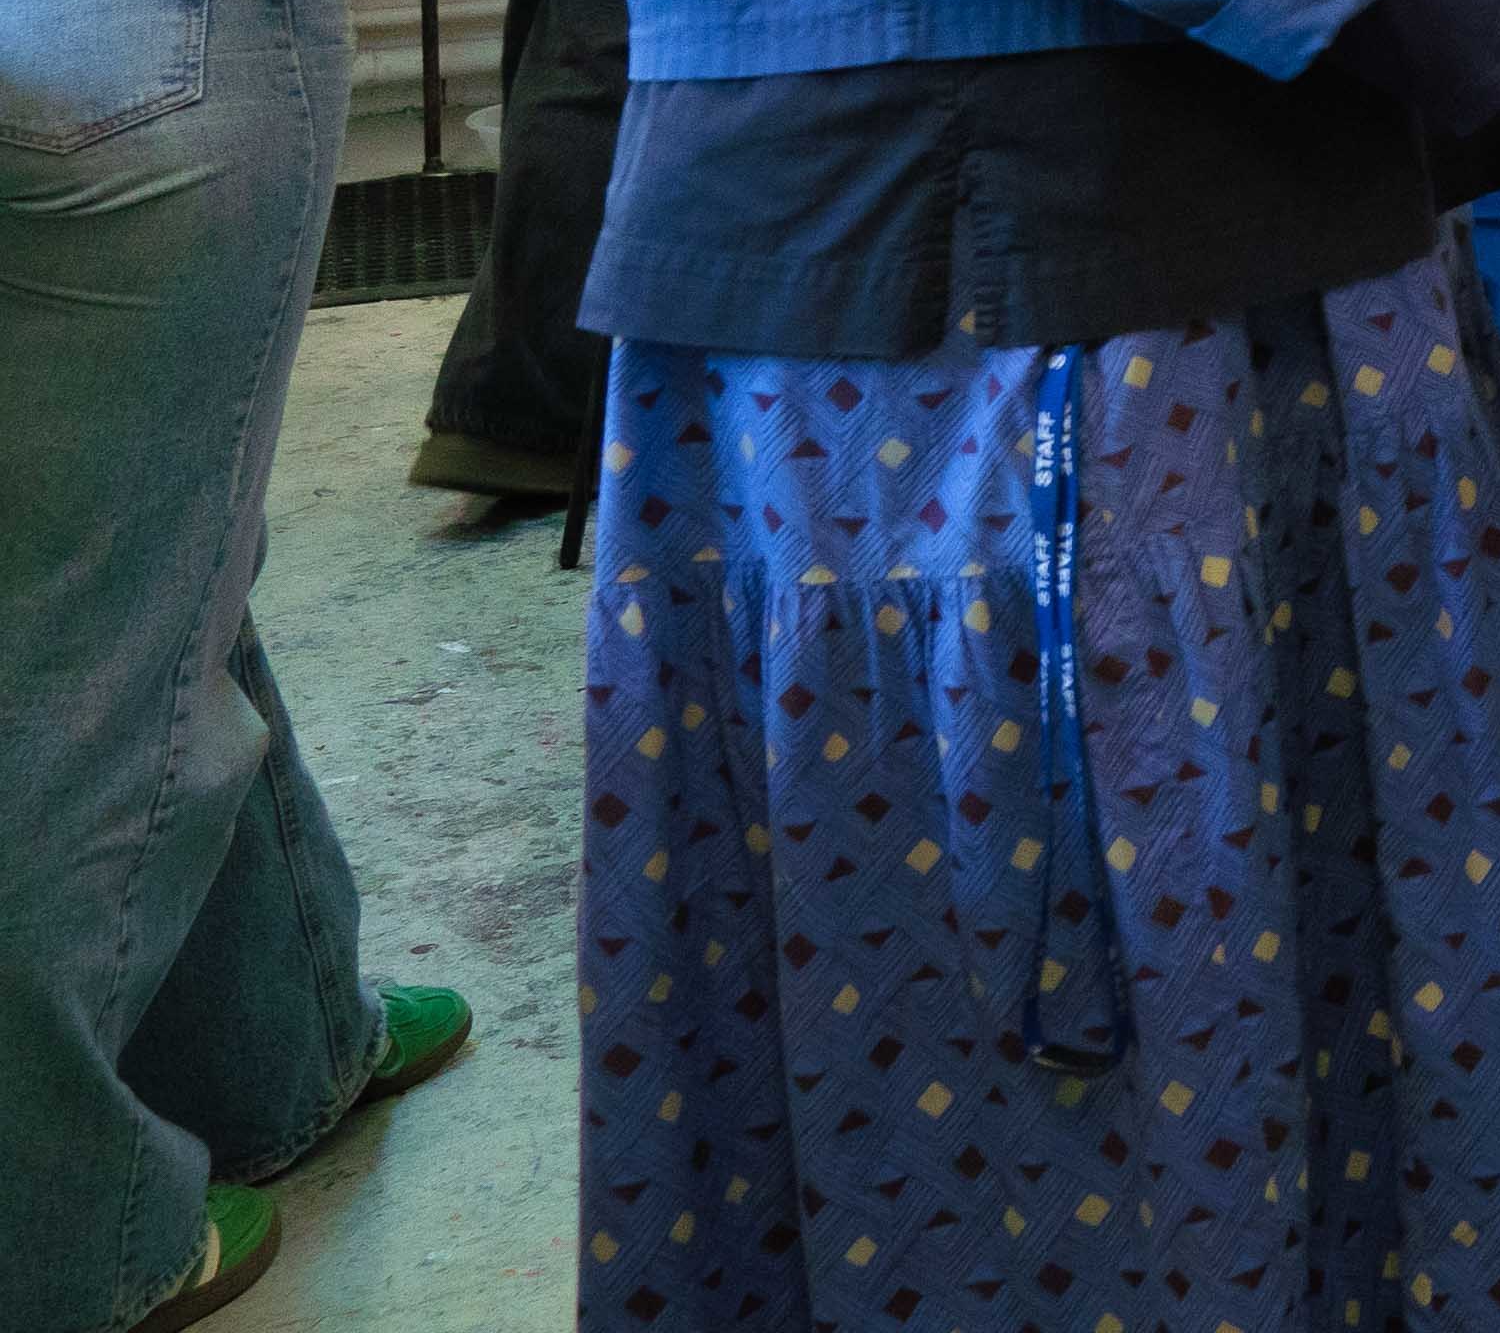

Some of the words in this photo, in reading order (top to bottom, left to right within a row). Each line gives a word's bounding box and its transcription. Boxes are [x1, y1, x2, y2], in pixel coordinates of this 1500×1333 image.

[1034, 410, 1056, 488] STAFF
[1034, 532, 1051, 608] STAFF
[1060, 643, 1078, 718] STAFF
